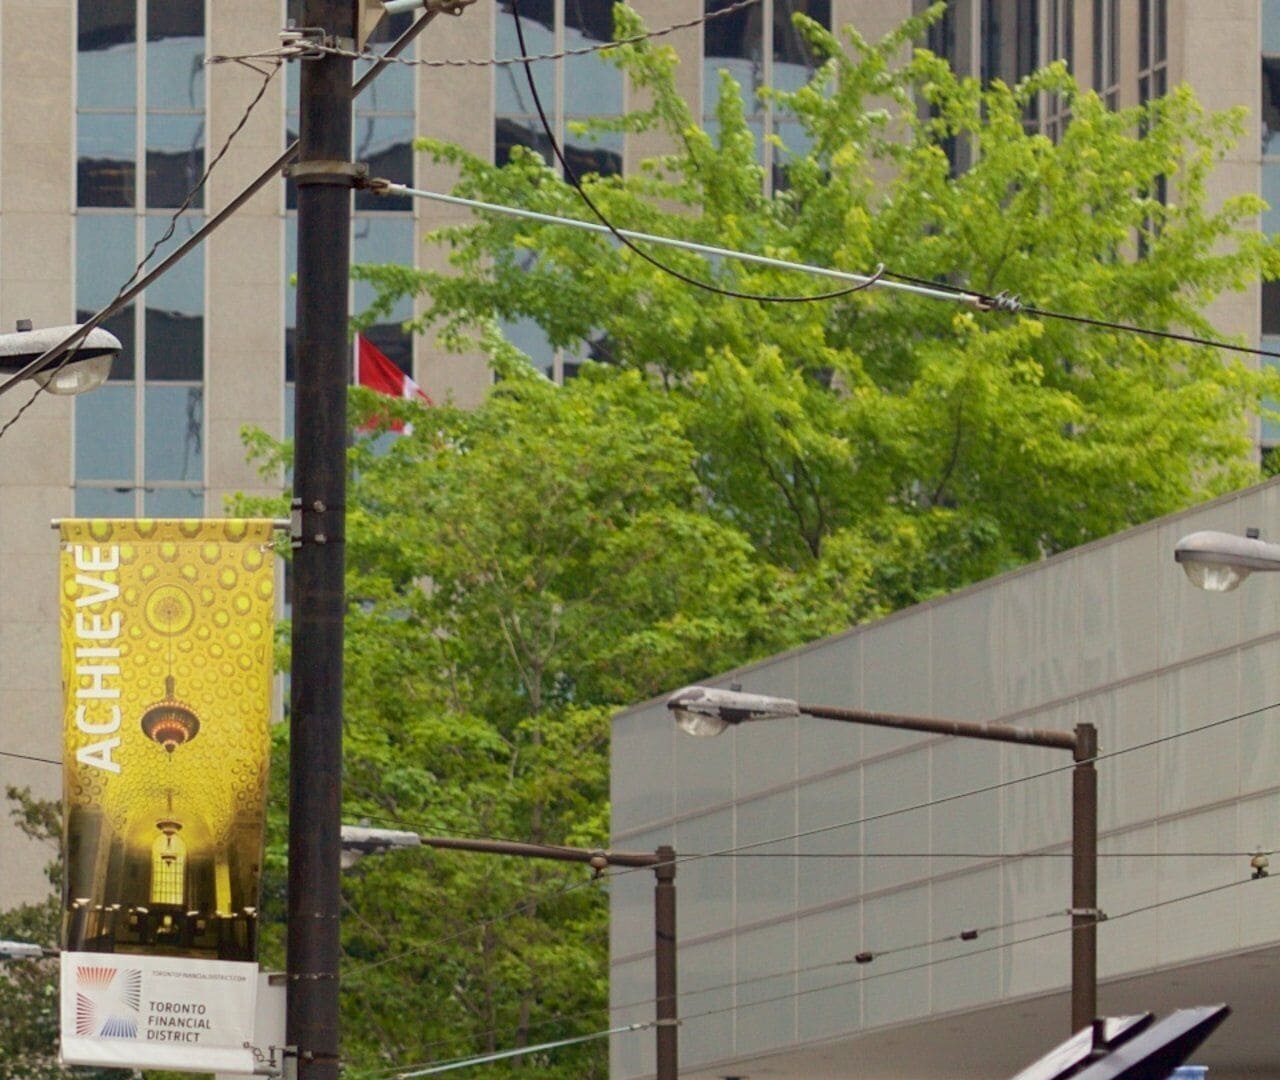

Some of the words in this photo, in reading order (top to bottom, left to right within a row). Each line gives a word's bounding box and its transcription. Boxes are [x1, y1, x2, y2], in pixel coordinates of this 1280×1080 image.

[75, 544, 121, 774] ACHIEVE
[149, 1001, 207, 1014] TORONTO
[148, 1015, 212, 1030] FINANCIAL
[147, 1030, 200, 1043] DISTRICT
